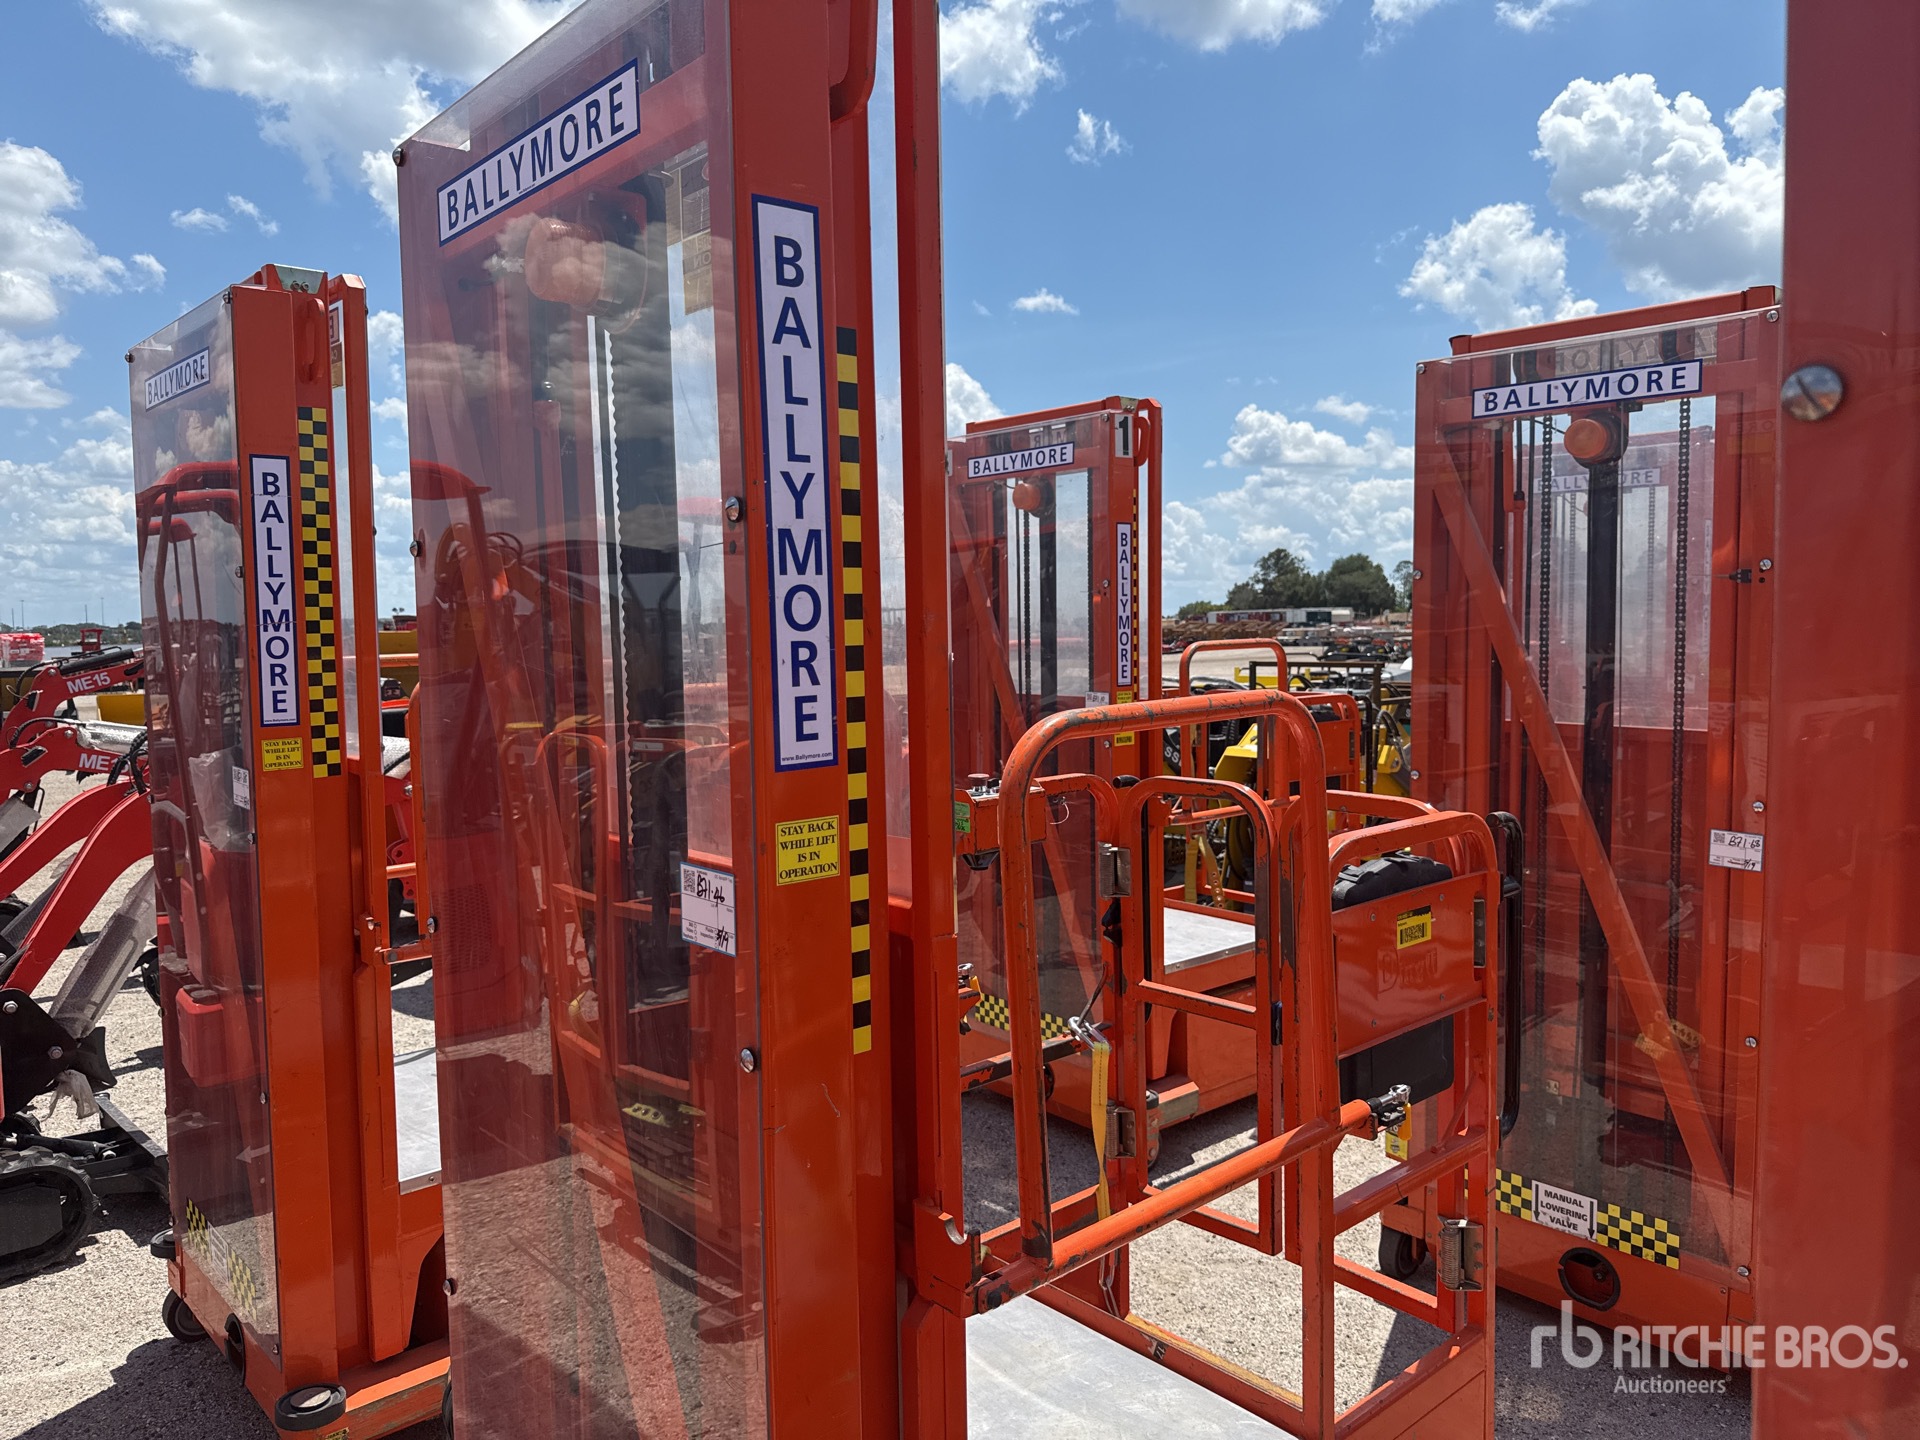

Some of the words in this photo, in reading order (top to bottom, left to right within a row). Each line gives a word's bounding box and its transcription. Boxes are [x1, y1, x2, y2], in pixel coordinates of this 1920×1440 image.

[447, 82, 625, 232] BALLYMORE
[147, 355, 205, 405] BALLYMORE
[1483, 366, 1687, 413] BALLYMORE
[973, 446, 1068, 475] BALLYMORE
[772, 235, 824, 743] BALLYMORE
[260, 472, 290, 714] BALLYMORE
[1118, 532, 1130, 679] BALLYMORE
[66, 672, 111, 694] ME15
[265, 760, 302, 768] OPERATION
[781, 752, 832, 762] www.Ballymore.com
[780, 825, 805, 837] STAY
[808, 820, 836, 833] BACK
[780, 837, 814, 851] WHILE
[816, 834, 837, 846] LIFT
[797, 853, 807, 863] IS
[809, 851, 820, 861] IN
[780, 862, 838, 880] OPERATION
[1544, 1190, 1585, 1208] MANUAL
[1540, 1201, 1588, 1222] LOWERING
[1549, 1216, 1579, 1231] VALVE
